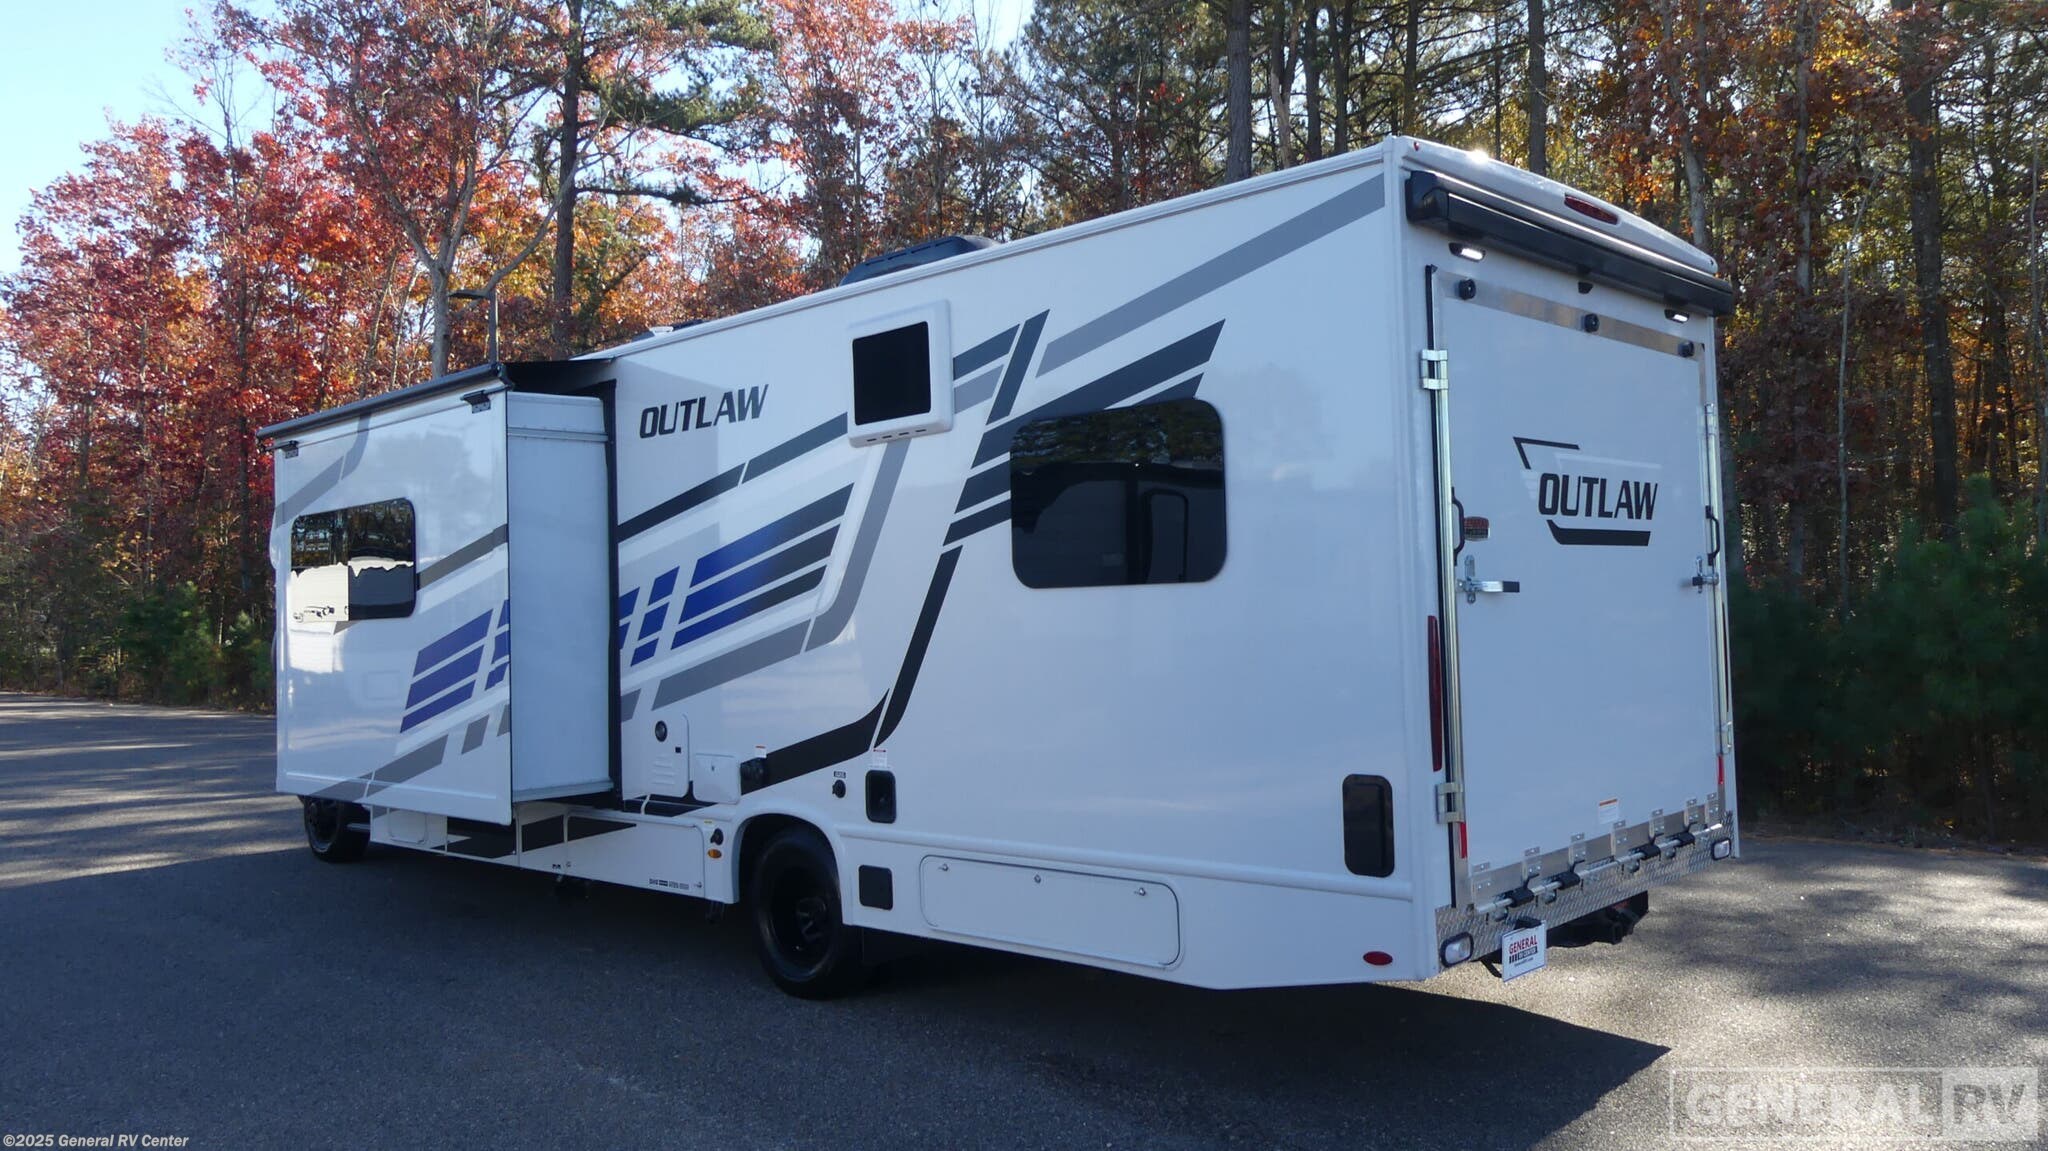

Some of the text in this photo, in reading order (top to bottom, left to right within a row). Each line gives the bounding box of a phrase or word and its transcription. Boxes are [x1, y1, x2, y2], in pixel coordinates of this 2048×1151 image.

[640, 384, 769, 439] OUTLAW
[1538, 473, 1658, 520] OUTLAW
[1509, 935, 1537, 954] GENERAL
